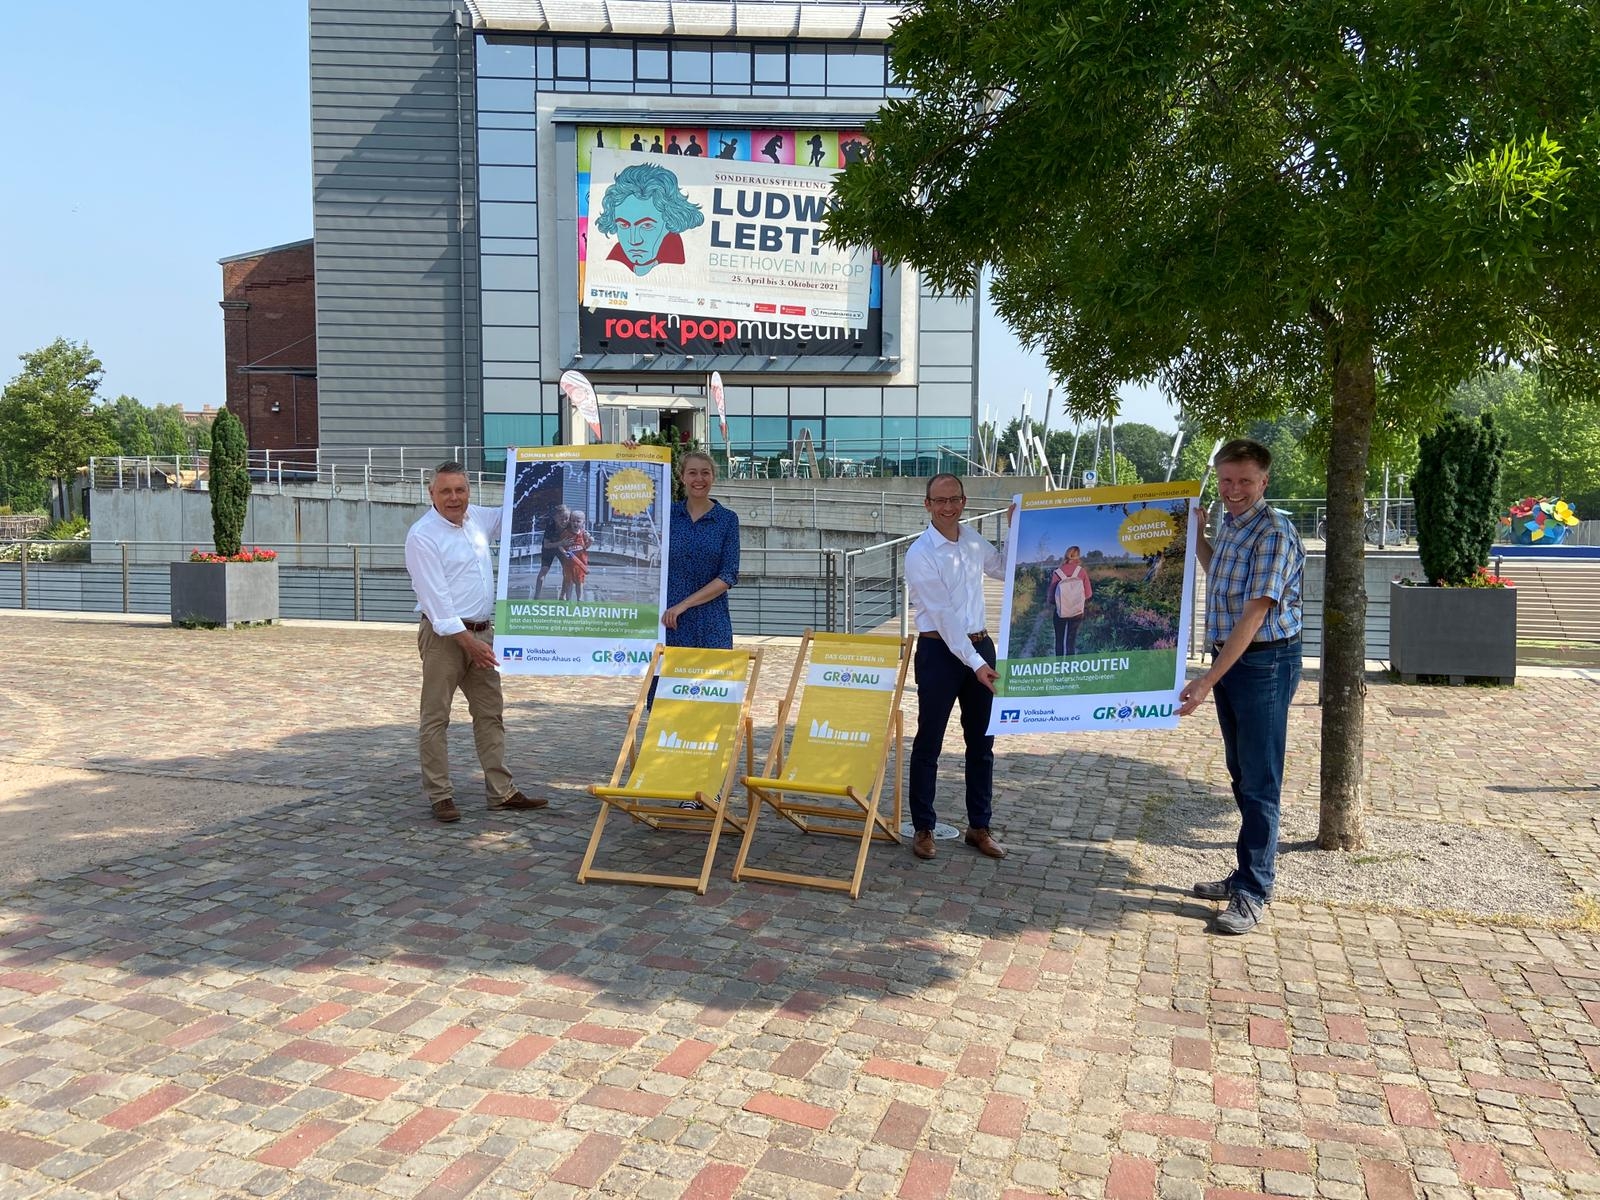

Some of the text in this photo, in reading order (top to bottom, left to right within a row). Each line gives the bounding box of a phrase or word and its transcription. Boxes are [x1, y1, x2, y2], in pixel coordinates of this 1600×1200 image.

[714, 173, 826, 190] SONDERAUSSTELLUNG
[712, 187, 840, 223] LUDW
[710, 220, 821, 256] LEBT!
[709, 252, 865, 277] BEETHOVEN IM POP
[732, 275, 838, 291] 25. April bis 3. Oktober 2021
[613, 483, 647, 493] SOMMER
[1132, 489, 1190, 499] gronau-inside.de
[620, 491, 652, 500] GRONAU
[1025, 499, 1053, 507] SOMMER
[1063, 496, 1092, 504] GRONAU
[1127, 520, 1167, 533] SOMMER
[1122, 528, 1173, 542] IN GRONAU
[510, 603, 638, 620] WASSERLABYRINTH
[526, 647, 556, 655] Volksbank
[526, 654, 571, 663] Gronau-Ahaus
[1010, 657, 1130, 677] WANDERROUTEN
[823, 671, 880, 685] GRONAU
[1043, 676, 1053, 684] den
[672, 684, 729, 698] GRONAU
[1023, 708, 1055, 716] Volksbank
[1023, 715, 1069, 723] Gronau-Ahaus
[1093, 703, 1173, 721] GRONAU
